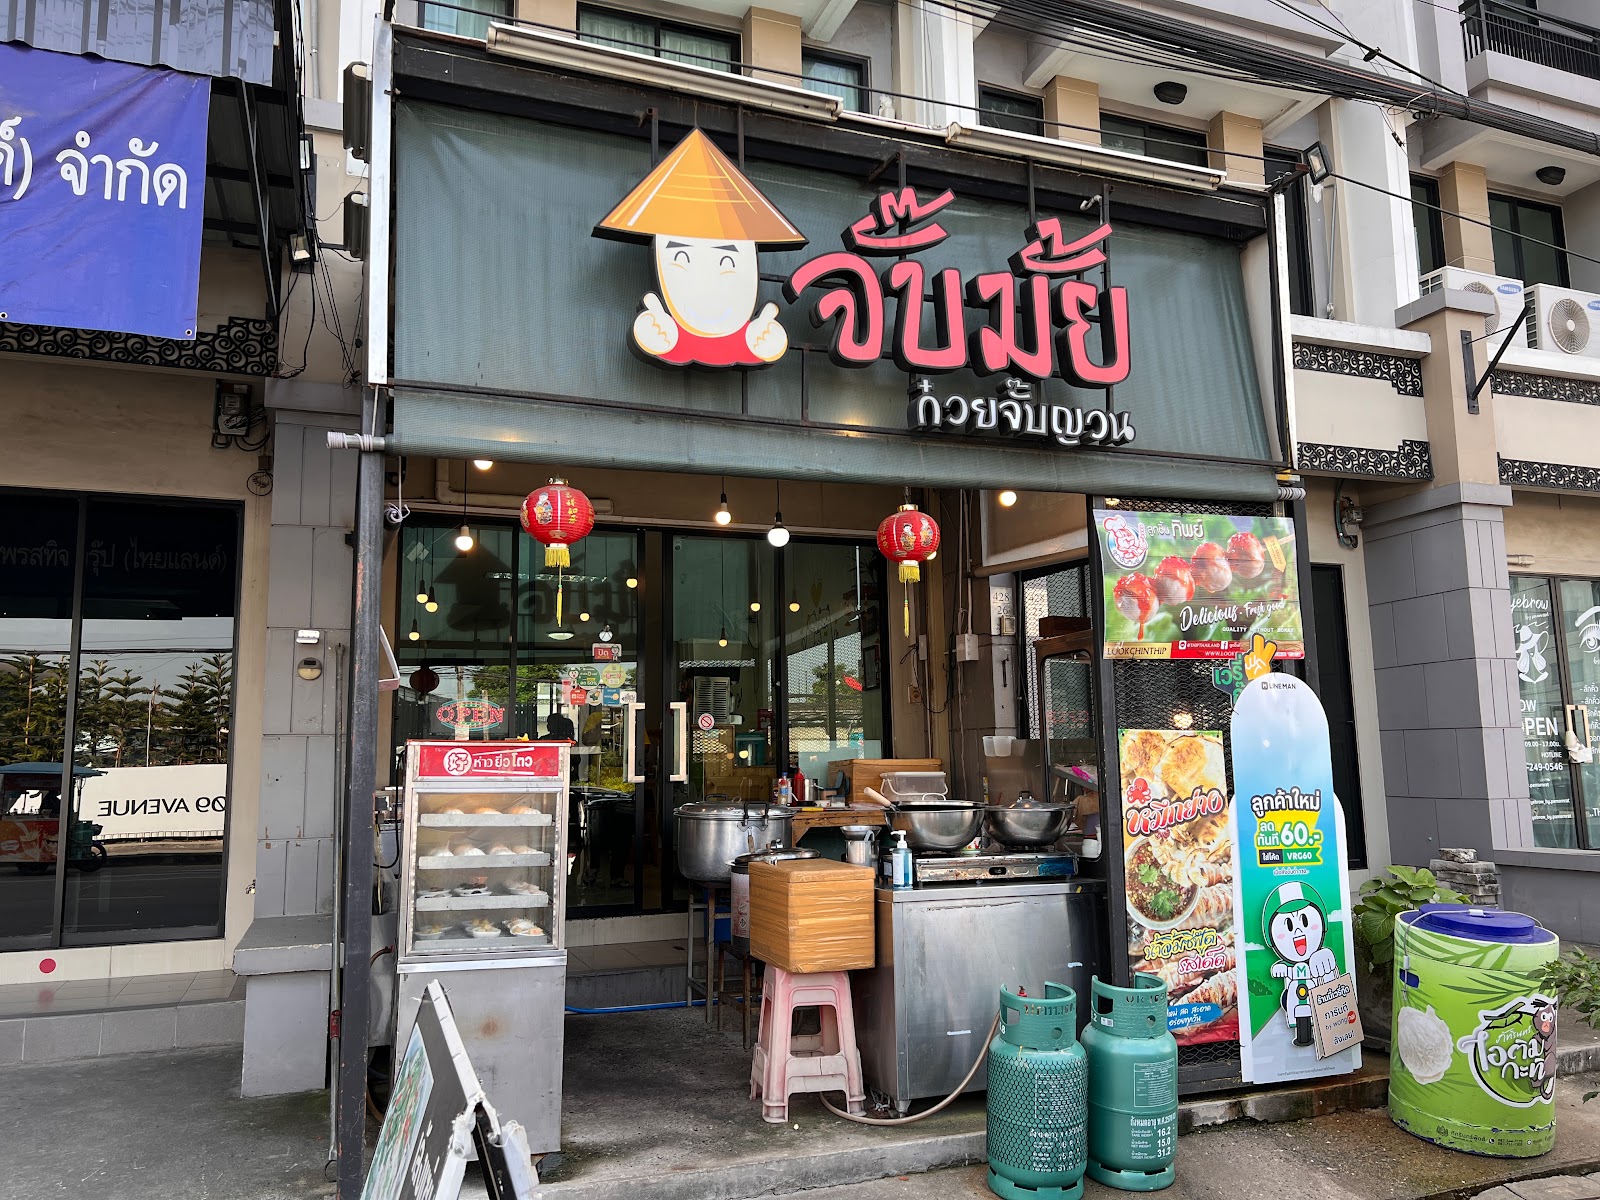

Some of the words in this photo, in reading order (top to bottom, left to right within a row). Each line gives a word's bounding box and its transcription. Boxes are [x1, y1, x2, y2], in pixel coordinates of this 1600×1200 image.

[56, 131, 187, 209] จำกัด
[790, 187, 1131, 385] จั๊บมั้ย
[917, 378, 1135, 446] ก๋วยจั๊บญวน
[1172, 520, 1204, 539] ทิพย์
[86, 540, 115, 577] รุ๊ป
[992, 592, 1009, 601] 428
[1180, 605, 1239, 631] Delicious
[1244, 601, 1265, 617] Fresh
[1107, 646, 1167, 656] LOOKCHINTHIP
[436, 706, 505, 723] OPEN
[1520, 717, 1558, 736] PEN
[1251, 787, 1320, 818] ลูกค้าใหม่
[1257, 832, 1280, 846] ทันที
[1260, 822, 1275, 832] ลด
[1281, 823, 1320, 846] 60.-
[1287, 851, 1313, 860] VRG60
[1180, 946, 1227, 973] รสเด็ด
[1325, 1002, 1349, 1019] การันตี
[1464, 1030, 1545, 1072] ไอติม
[1502, 1058, 1546, 1080] กะทิ
[1157, 1126, 1171, 1137] 16.2
[1157, 1137, 1171, 1148] 15.0
[1157, 1147, 1171, 1157] 31.2
